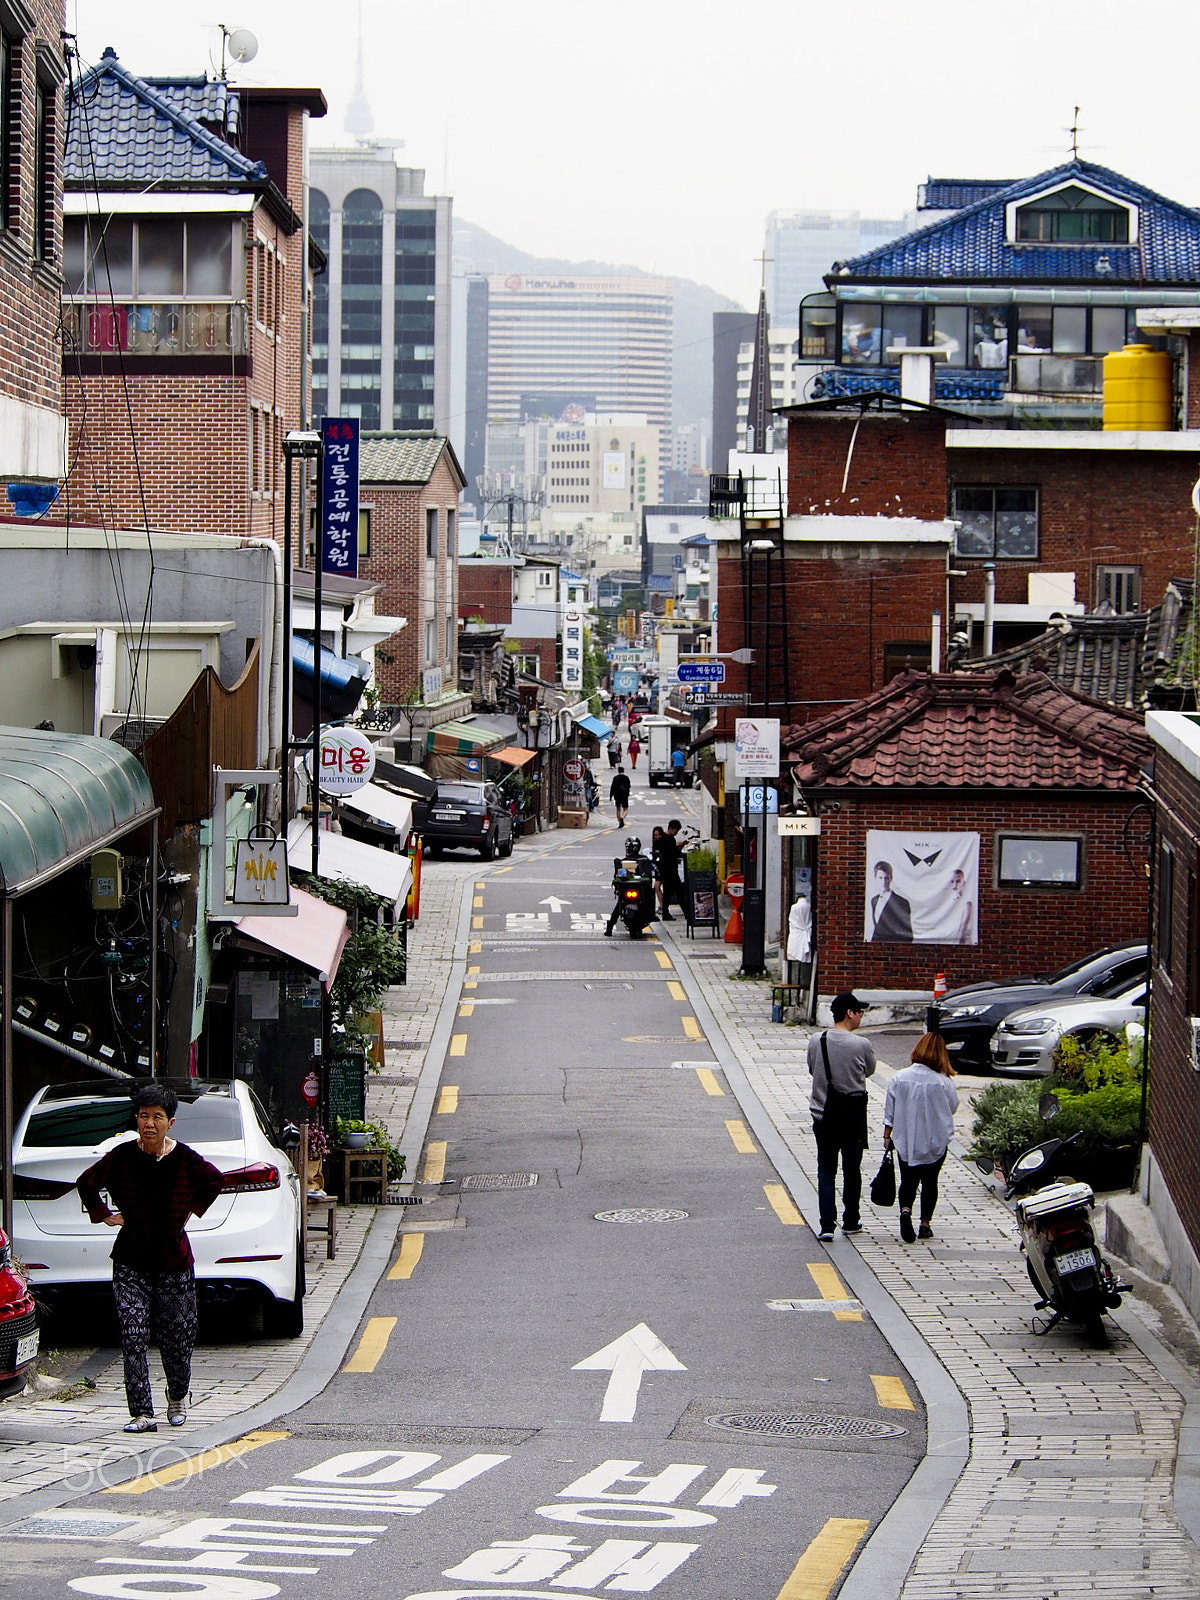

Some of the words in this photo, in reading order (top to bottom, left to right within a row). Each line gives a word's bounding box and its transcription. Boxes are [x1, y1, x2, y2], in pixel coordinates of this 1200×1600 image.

[326, 443, 352, 567] 전통공예학원
[566, 627, 580, 682] 목욕탕
[696, 666, 723, 674] 계동6길
[321, 746, 370, 774] 미용
[1066, 1255, 1092, 1270] 1506
